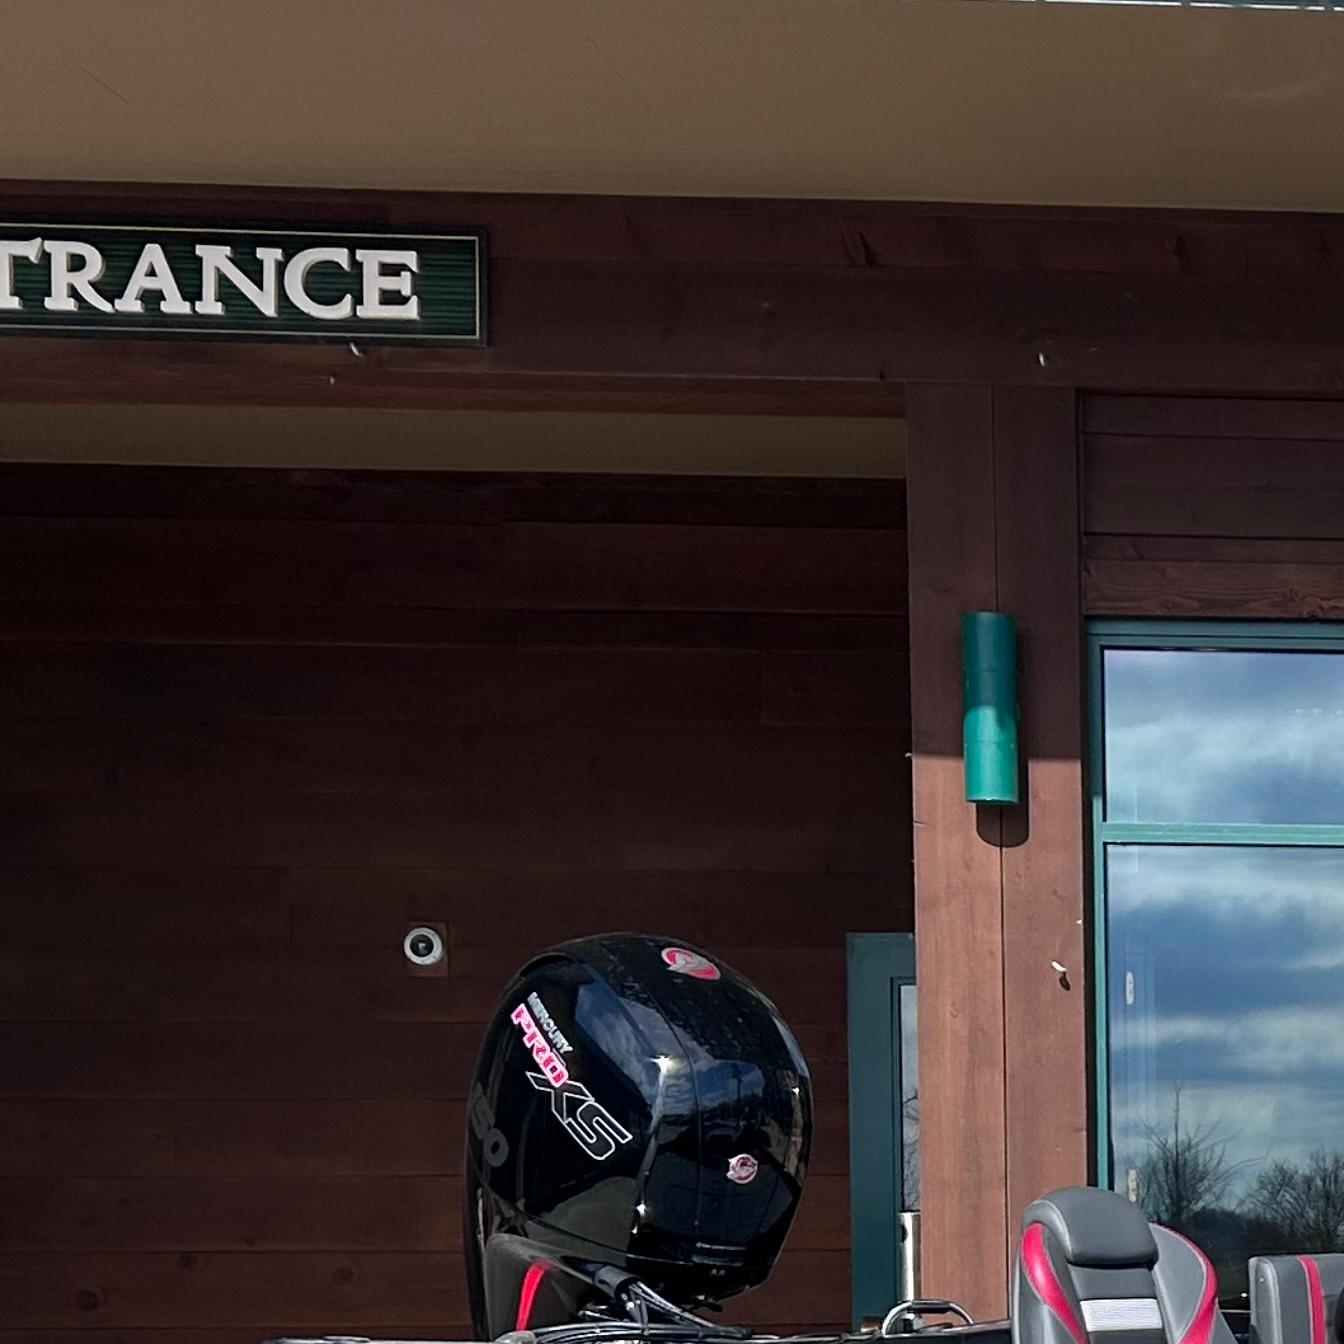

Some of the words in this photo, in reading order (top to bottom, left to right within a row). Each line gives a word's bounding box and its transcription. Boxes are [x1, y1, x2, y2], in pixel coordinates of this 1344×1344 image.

[0, 237, 420, 320] TRANCE
[510, 1003, 568, 1087] PRO
[525, 1071, 633, 1160] XS
